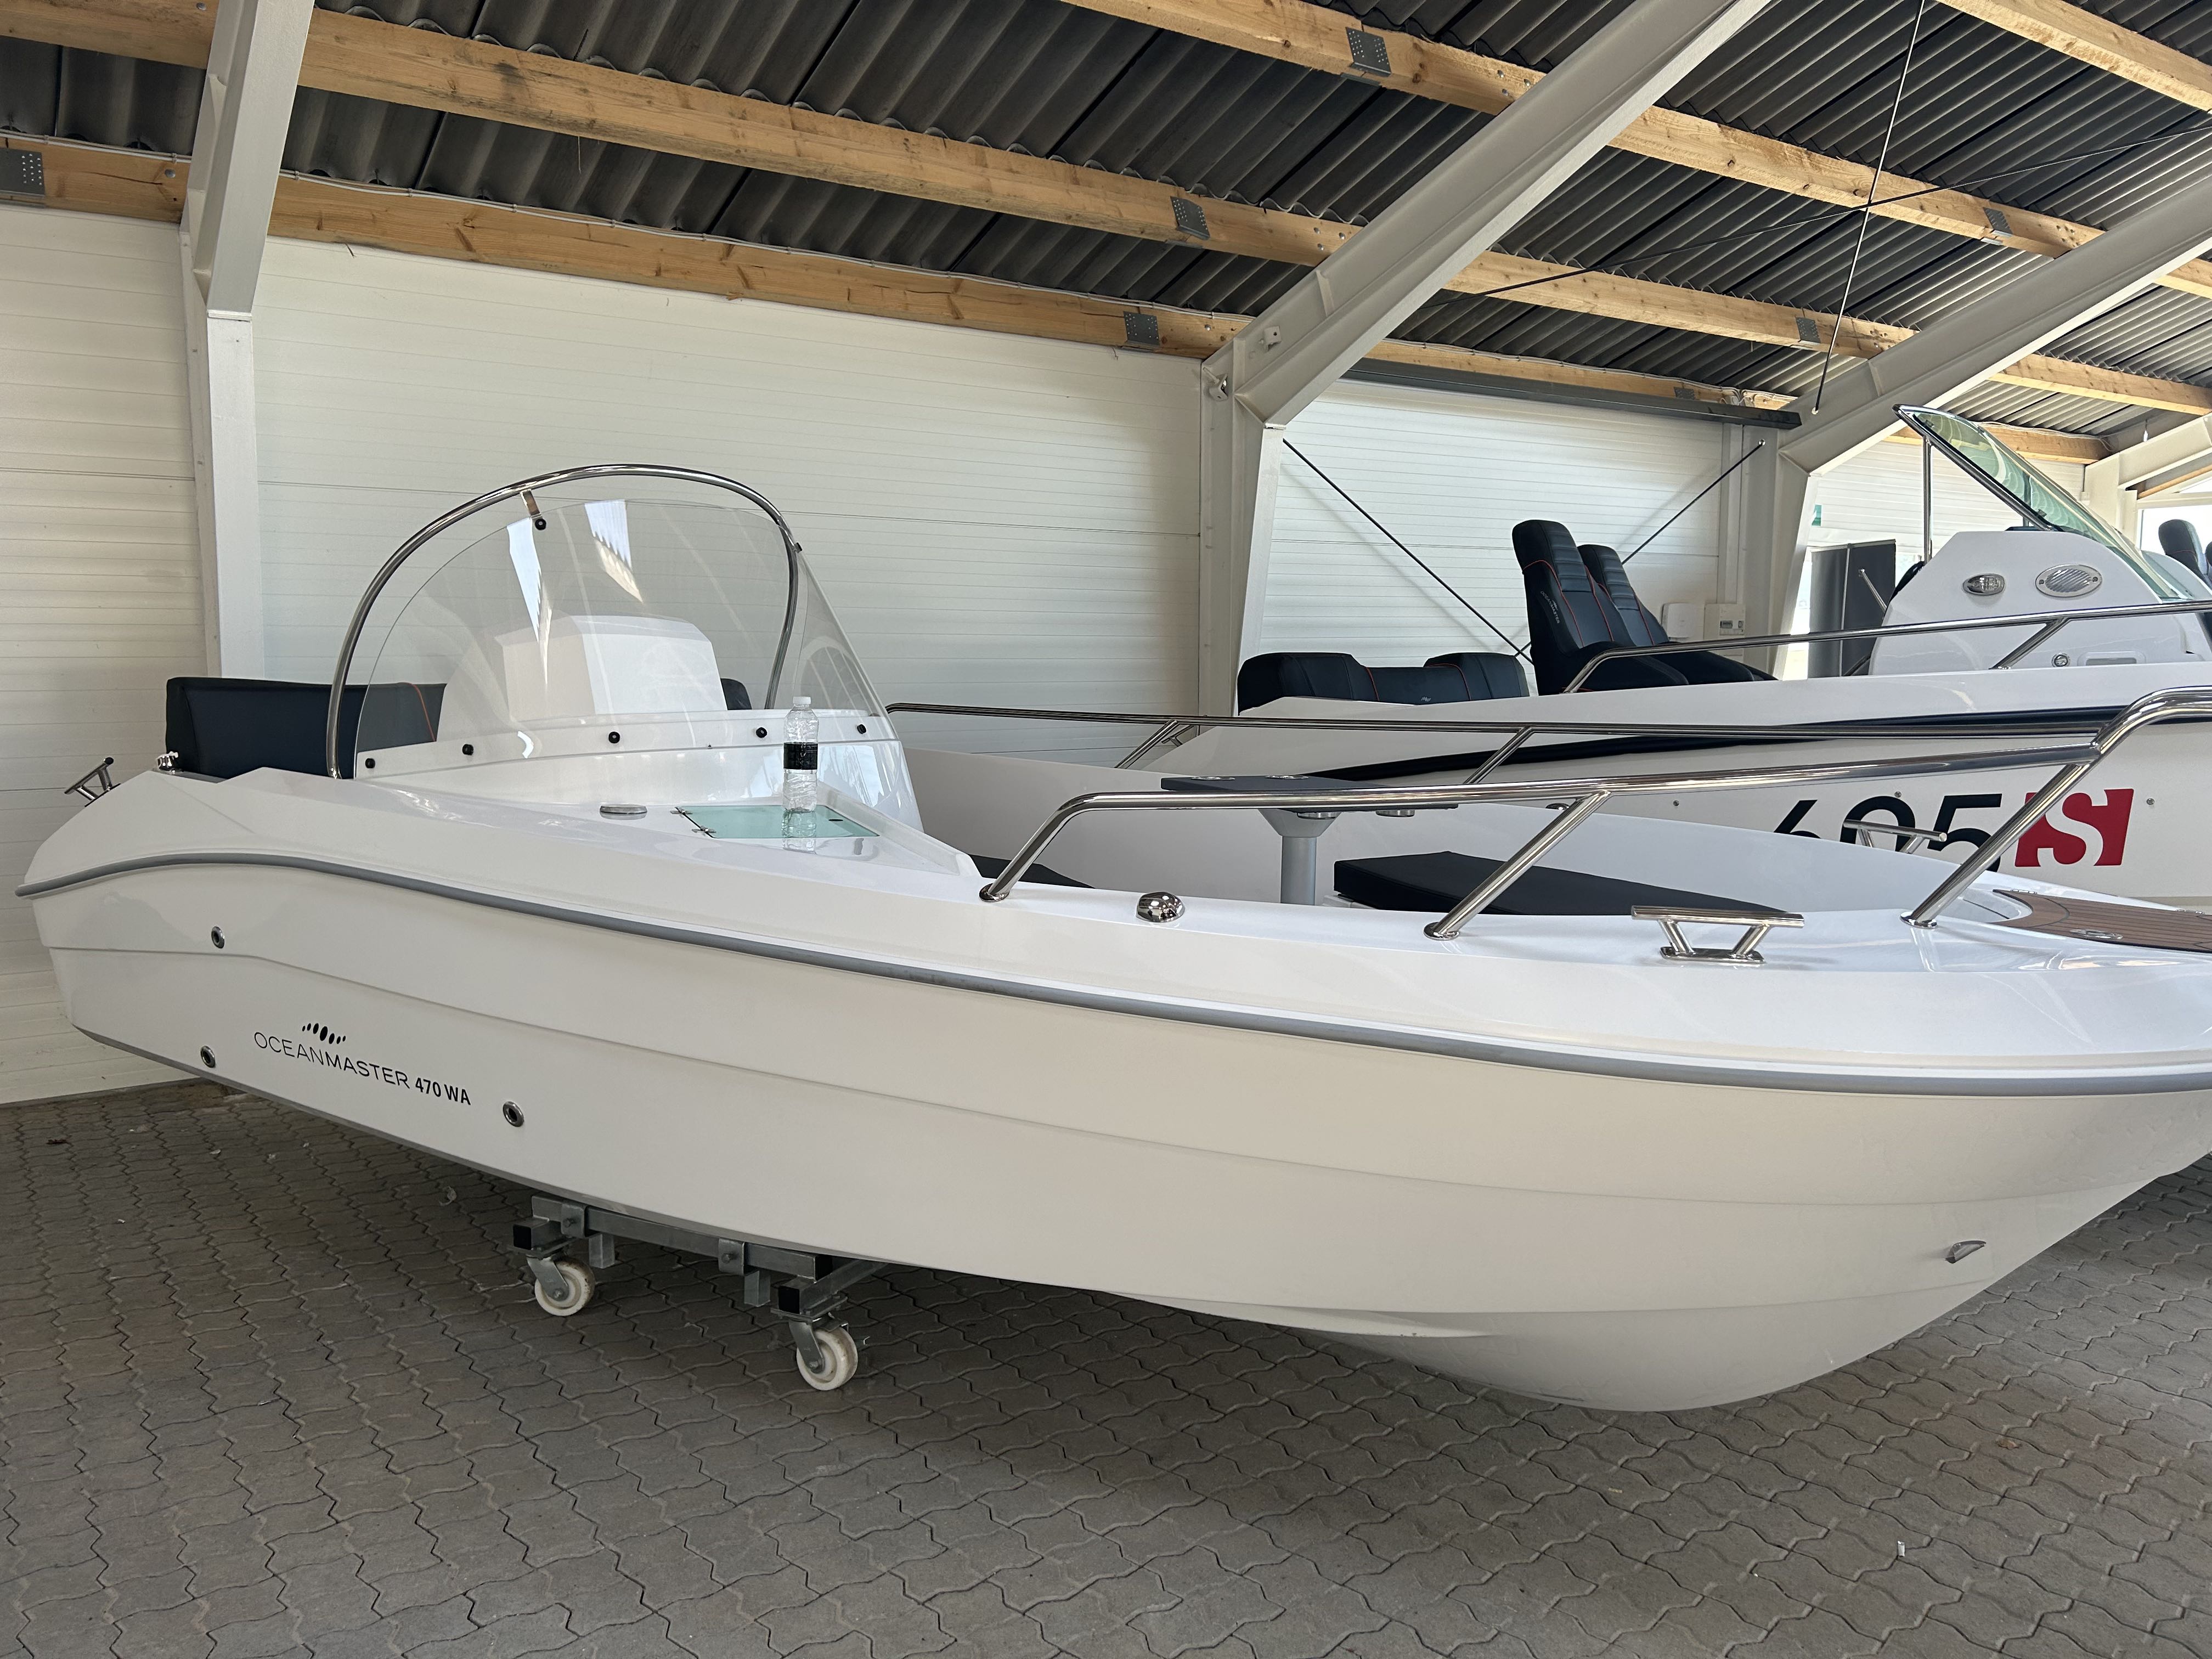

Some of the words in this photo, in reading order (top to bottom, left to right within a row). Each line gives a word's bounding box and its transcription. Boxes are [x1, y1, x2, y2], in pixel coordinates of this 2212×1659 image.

[254, 1031, 410, 1089] OCEANMASTER
[415, 1077, 442, 1098] 470
[443, 1084, 471, 1105] WA
